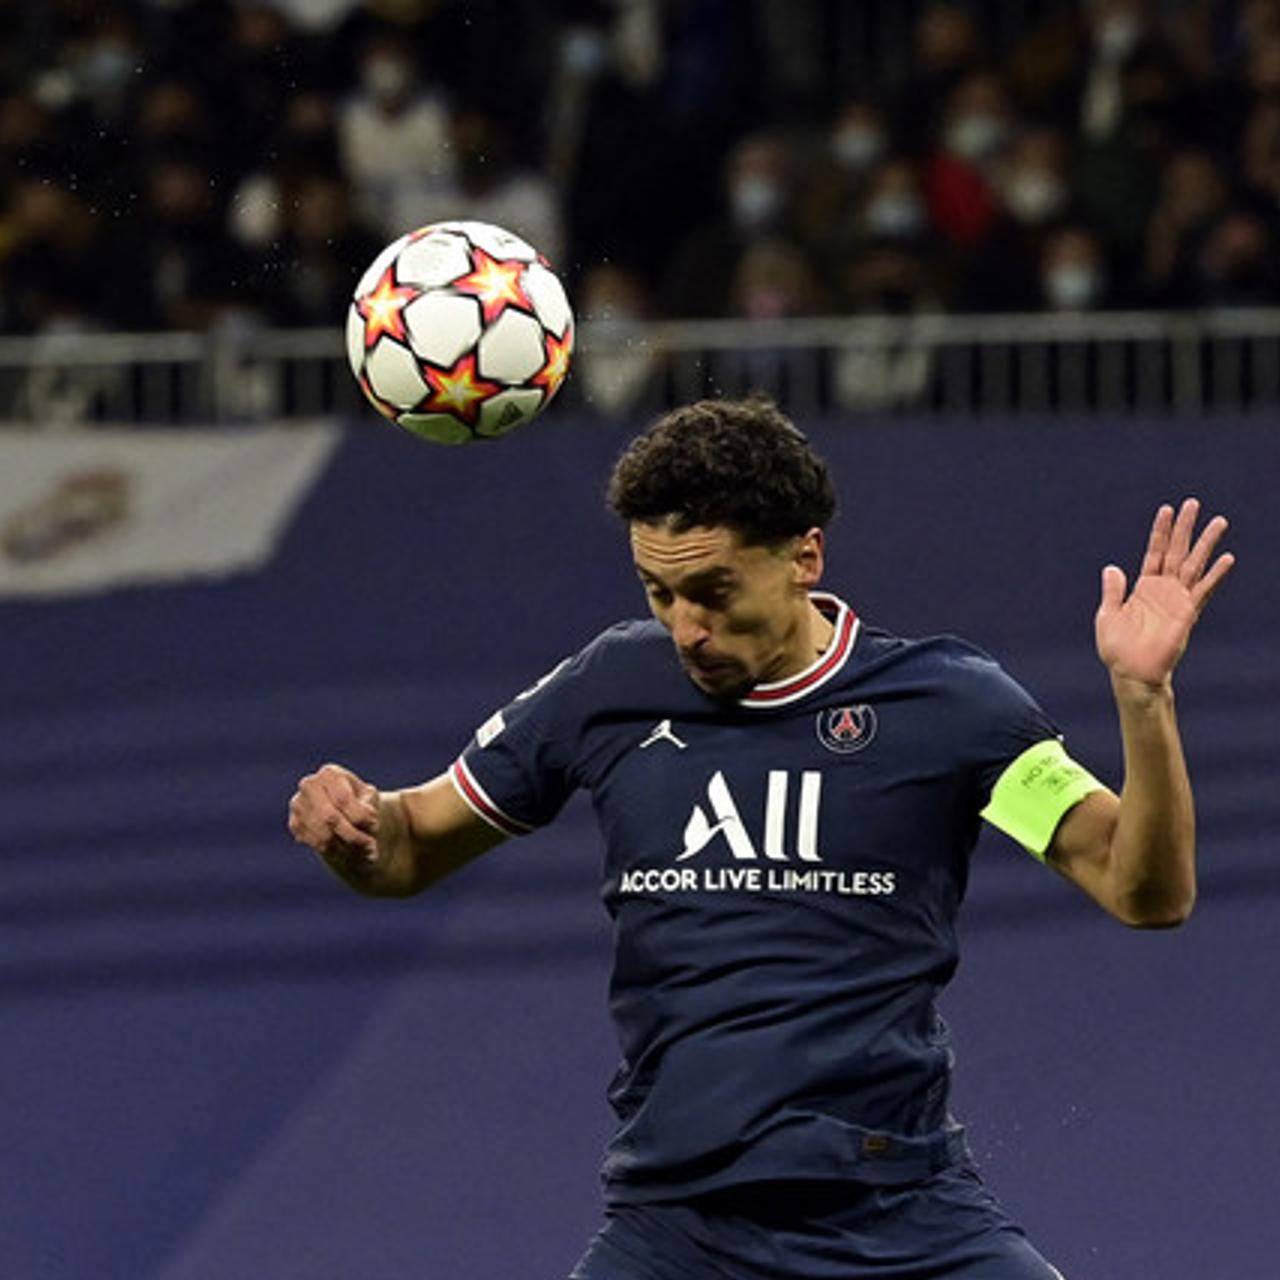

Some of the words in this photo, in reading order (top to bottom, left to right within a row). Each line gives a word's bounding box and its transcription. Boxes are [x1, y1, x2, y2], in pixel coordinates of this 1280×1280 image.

[620, 868, 698, 894] ACCOR
[704, 868, 762, 891] LIVE
[767, 869, 896, 895] LIMITLESS
